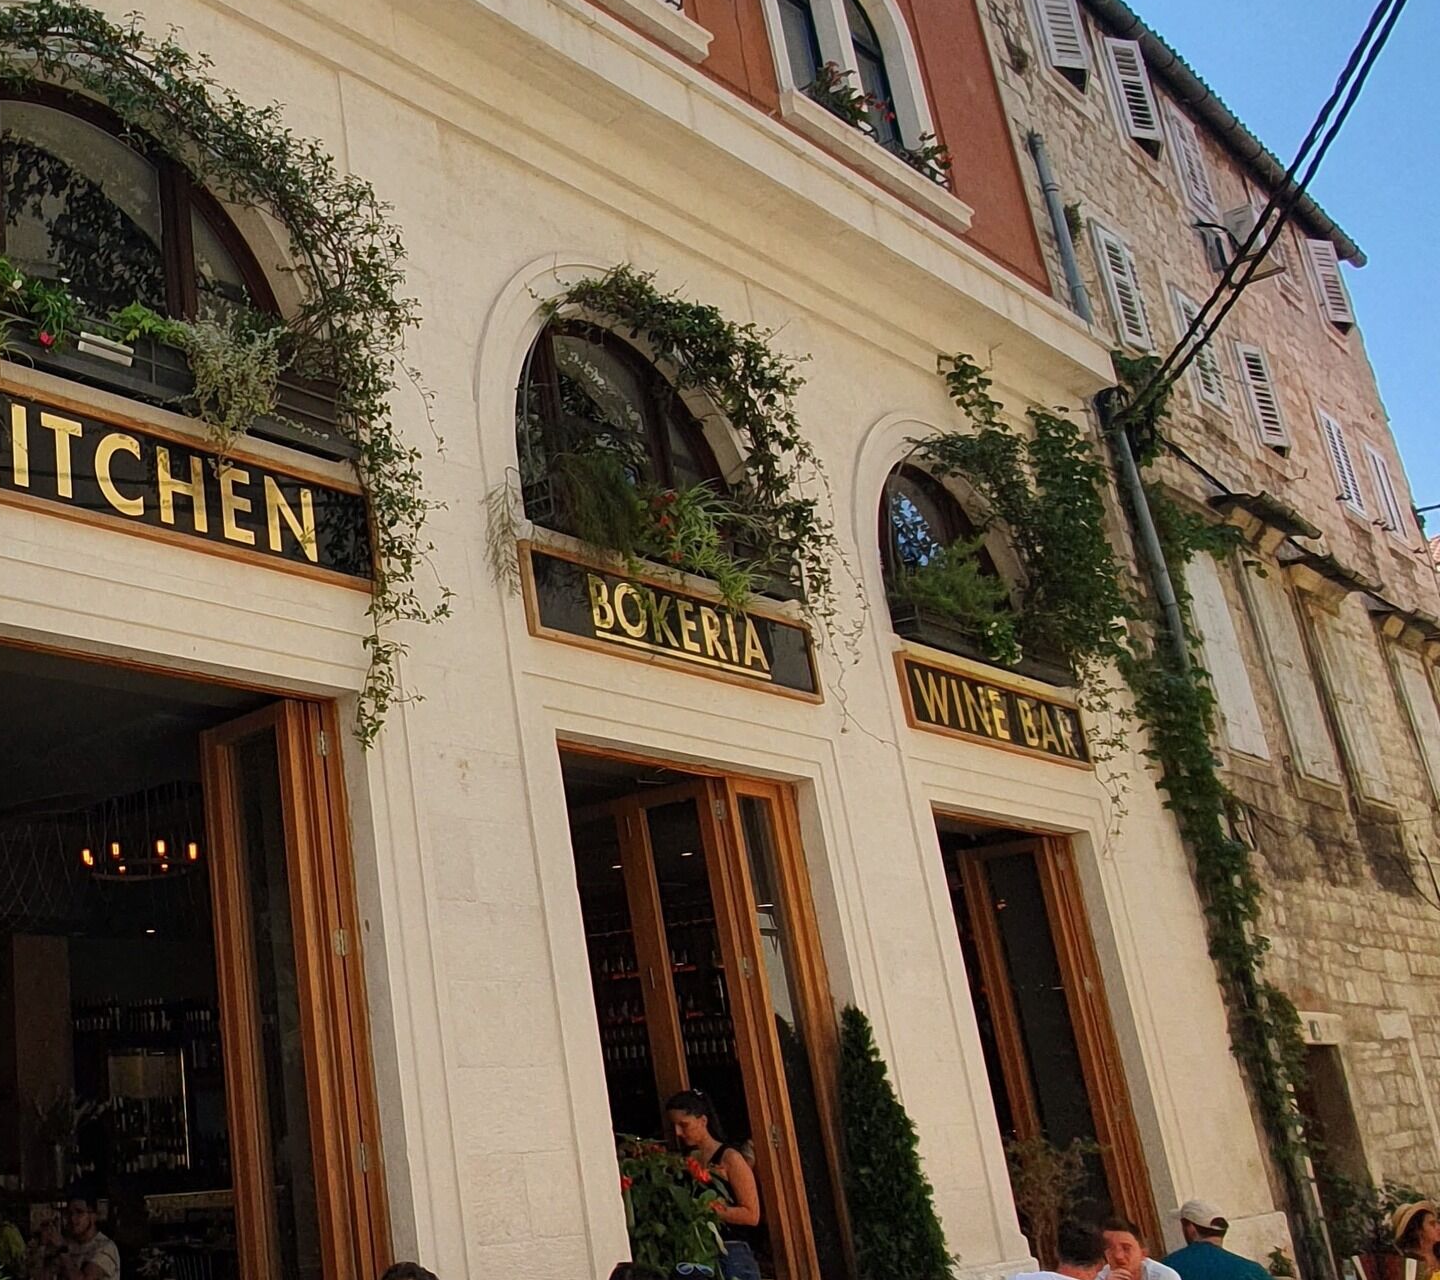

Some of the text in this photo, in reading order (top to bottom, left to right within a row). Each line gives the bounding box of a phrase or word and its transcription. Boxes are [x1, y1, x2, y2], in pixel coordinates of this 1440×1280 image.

[587, 573, 770, 671] BOKERIA
[913, 668, 1080, 759] WINE BAR
